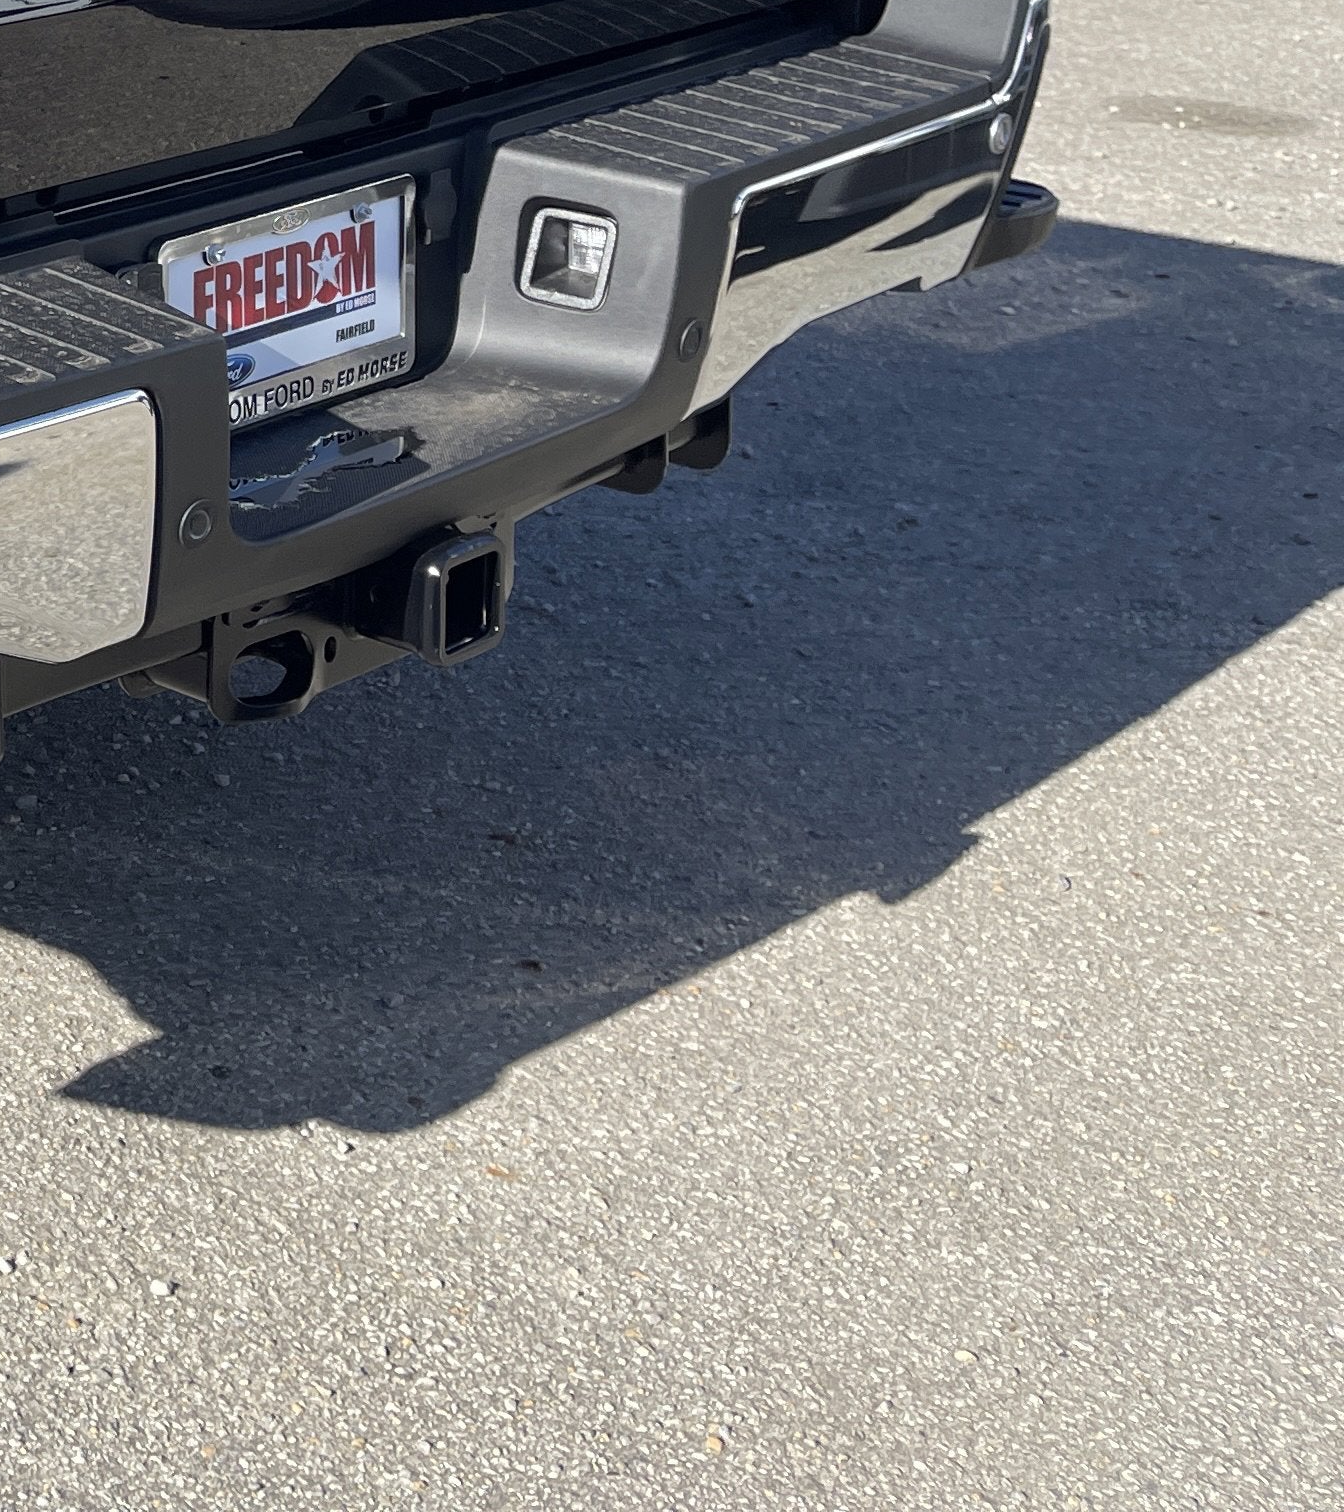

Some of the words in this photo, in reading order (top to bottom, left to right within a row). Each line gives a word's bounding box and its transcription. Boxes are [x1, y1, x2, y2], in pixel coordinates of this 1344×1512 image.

[193, 221, 376, 335] FREEDOM
[336, 319, 376, 343] FAIRFIELD
[264, 375, 315, 413] FORD
[337, 367, 355, 388] ED
[358, 350, 408, 382] MORSE
